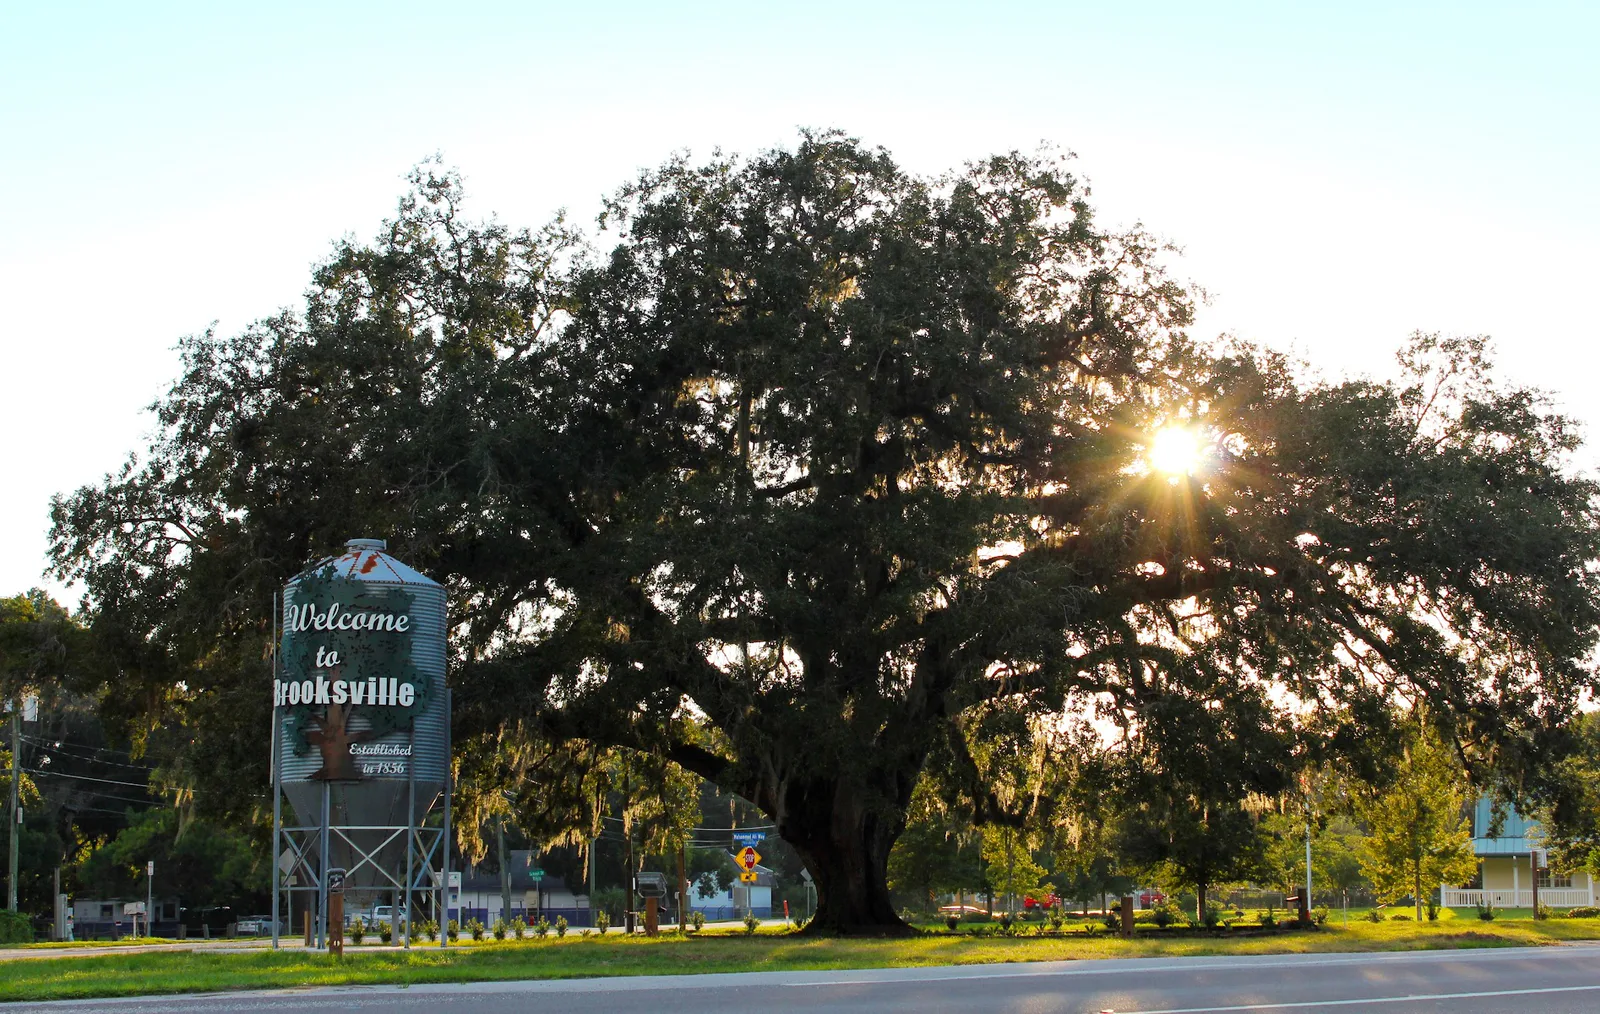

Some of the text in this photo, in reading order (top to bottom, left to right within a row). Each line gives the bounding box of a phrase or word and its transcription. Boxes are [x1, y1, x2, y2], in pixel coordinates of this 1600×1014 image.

[289, 602, 409, 633] Welcome
[316, 645, 340, 667] to
[274, 675, 414, 707] Brooksville
[349, 743, 412, 756] Established
[363, 762, 404, 774] in 1856
[746, 853, 755, 863] STOP
